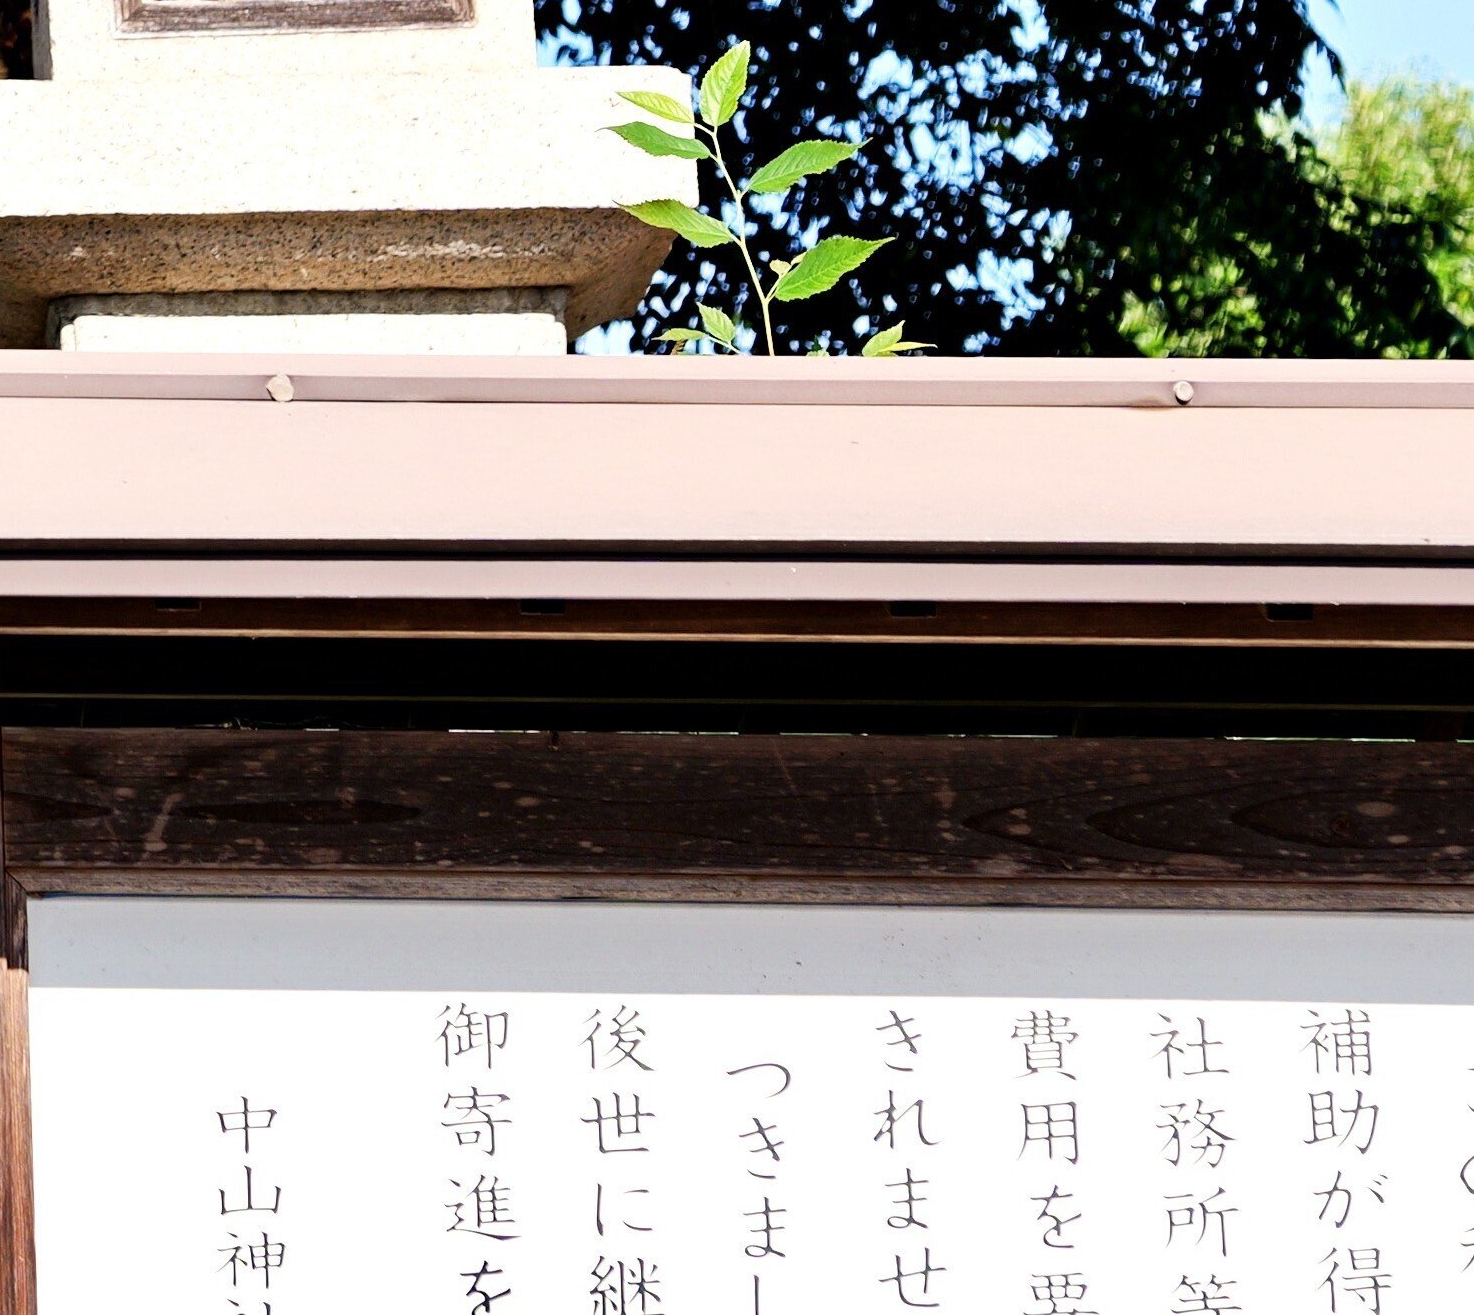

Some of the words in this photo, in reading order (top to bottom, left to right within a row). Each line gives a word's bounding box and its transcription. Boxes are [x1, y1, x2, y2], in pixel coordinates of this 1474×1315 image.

[216, 1096, 286, 1315] 中山神
[434, 1002, 521, 1315] 御寄進を
[578, 1005, 665, 1315] 後世に継
[873, 1010, 947, 1308] きれませ
[1298, 1009, 1393, 1315] 補助が得
